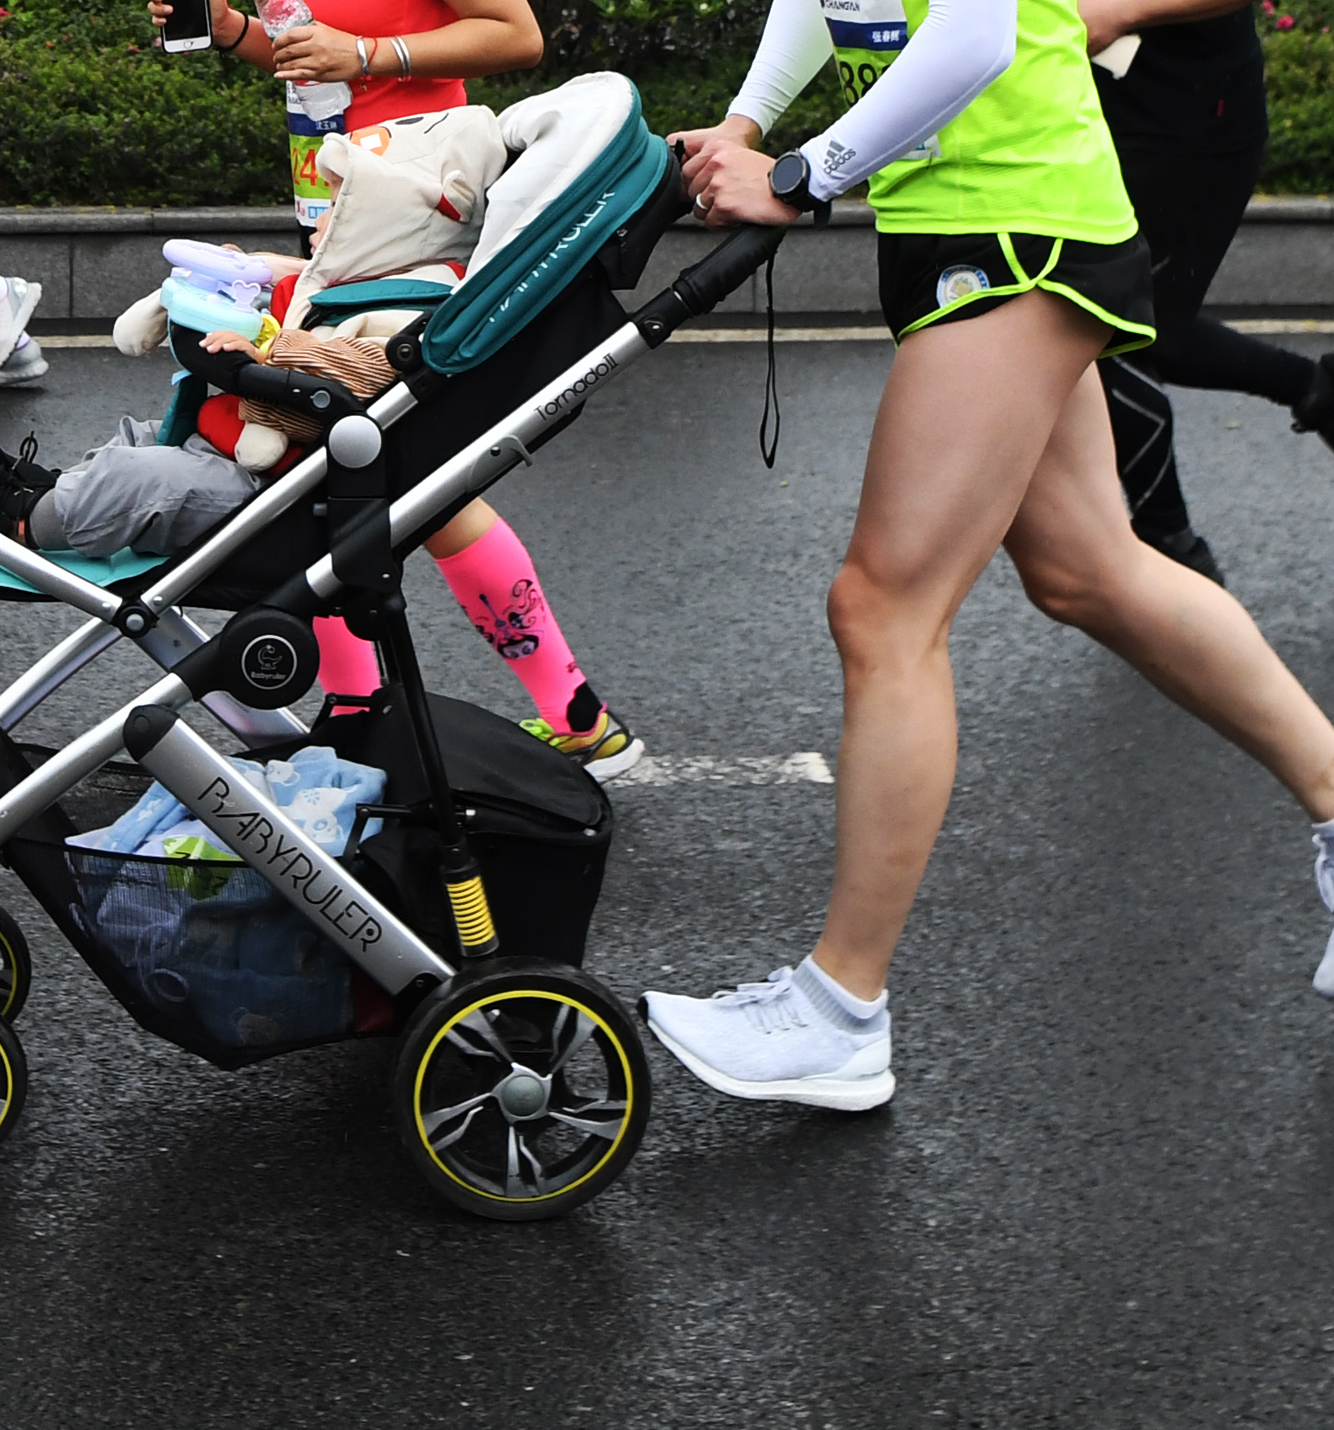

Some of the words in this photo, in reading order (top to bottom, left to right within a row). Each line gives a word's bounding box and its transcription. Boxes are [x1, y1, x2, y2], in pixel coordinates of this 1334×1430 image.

[824, 0, 860, 12] CHANGAN
[839, 61, 890, 108] 88
[292, 147, 330, 187] 24
[823, 148, 857, 175] adidas
[197, 776, 383, 953] BABYRULER
